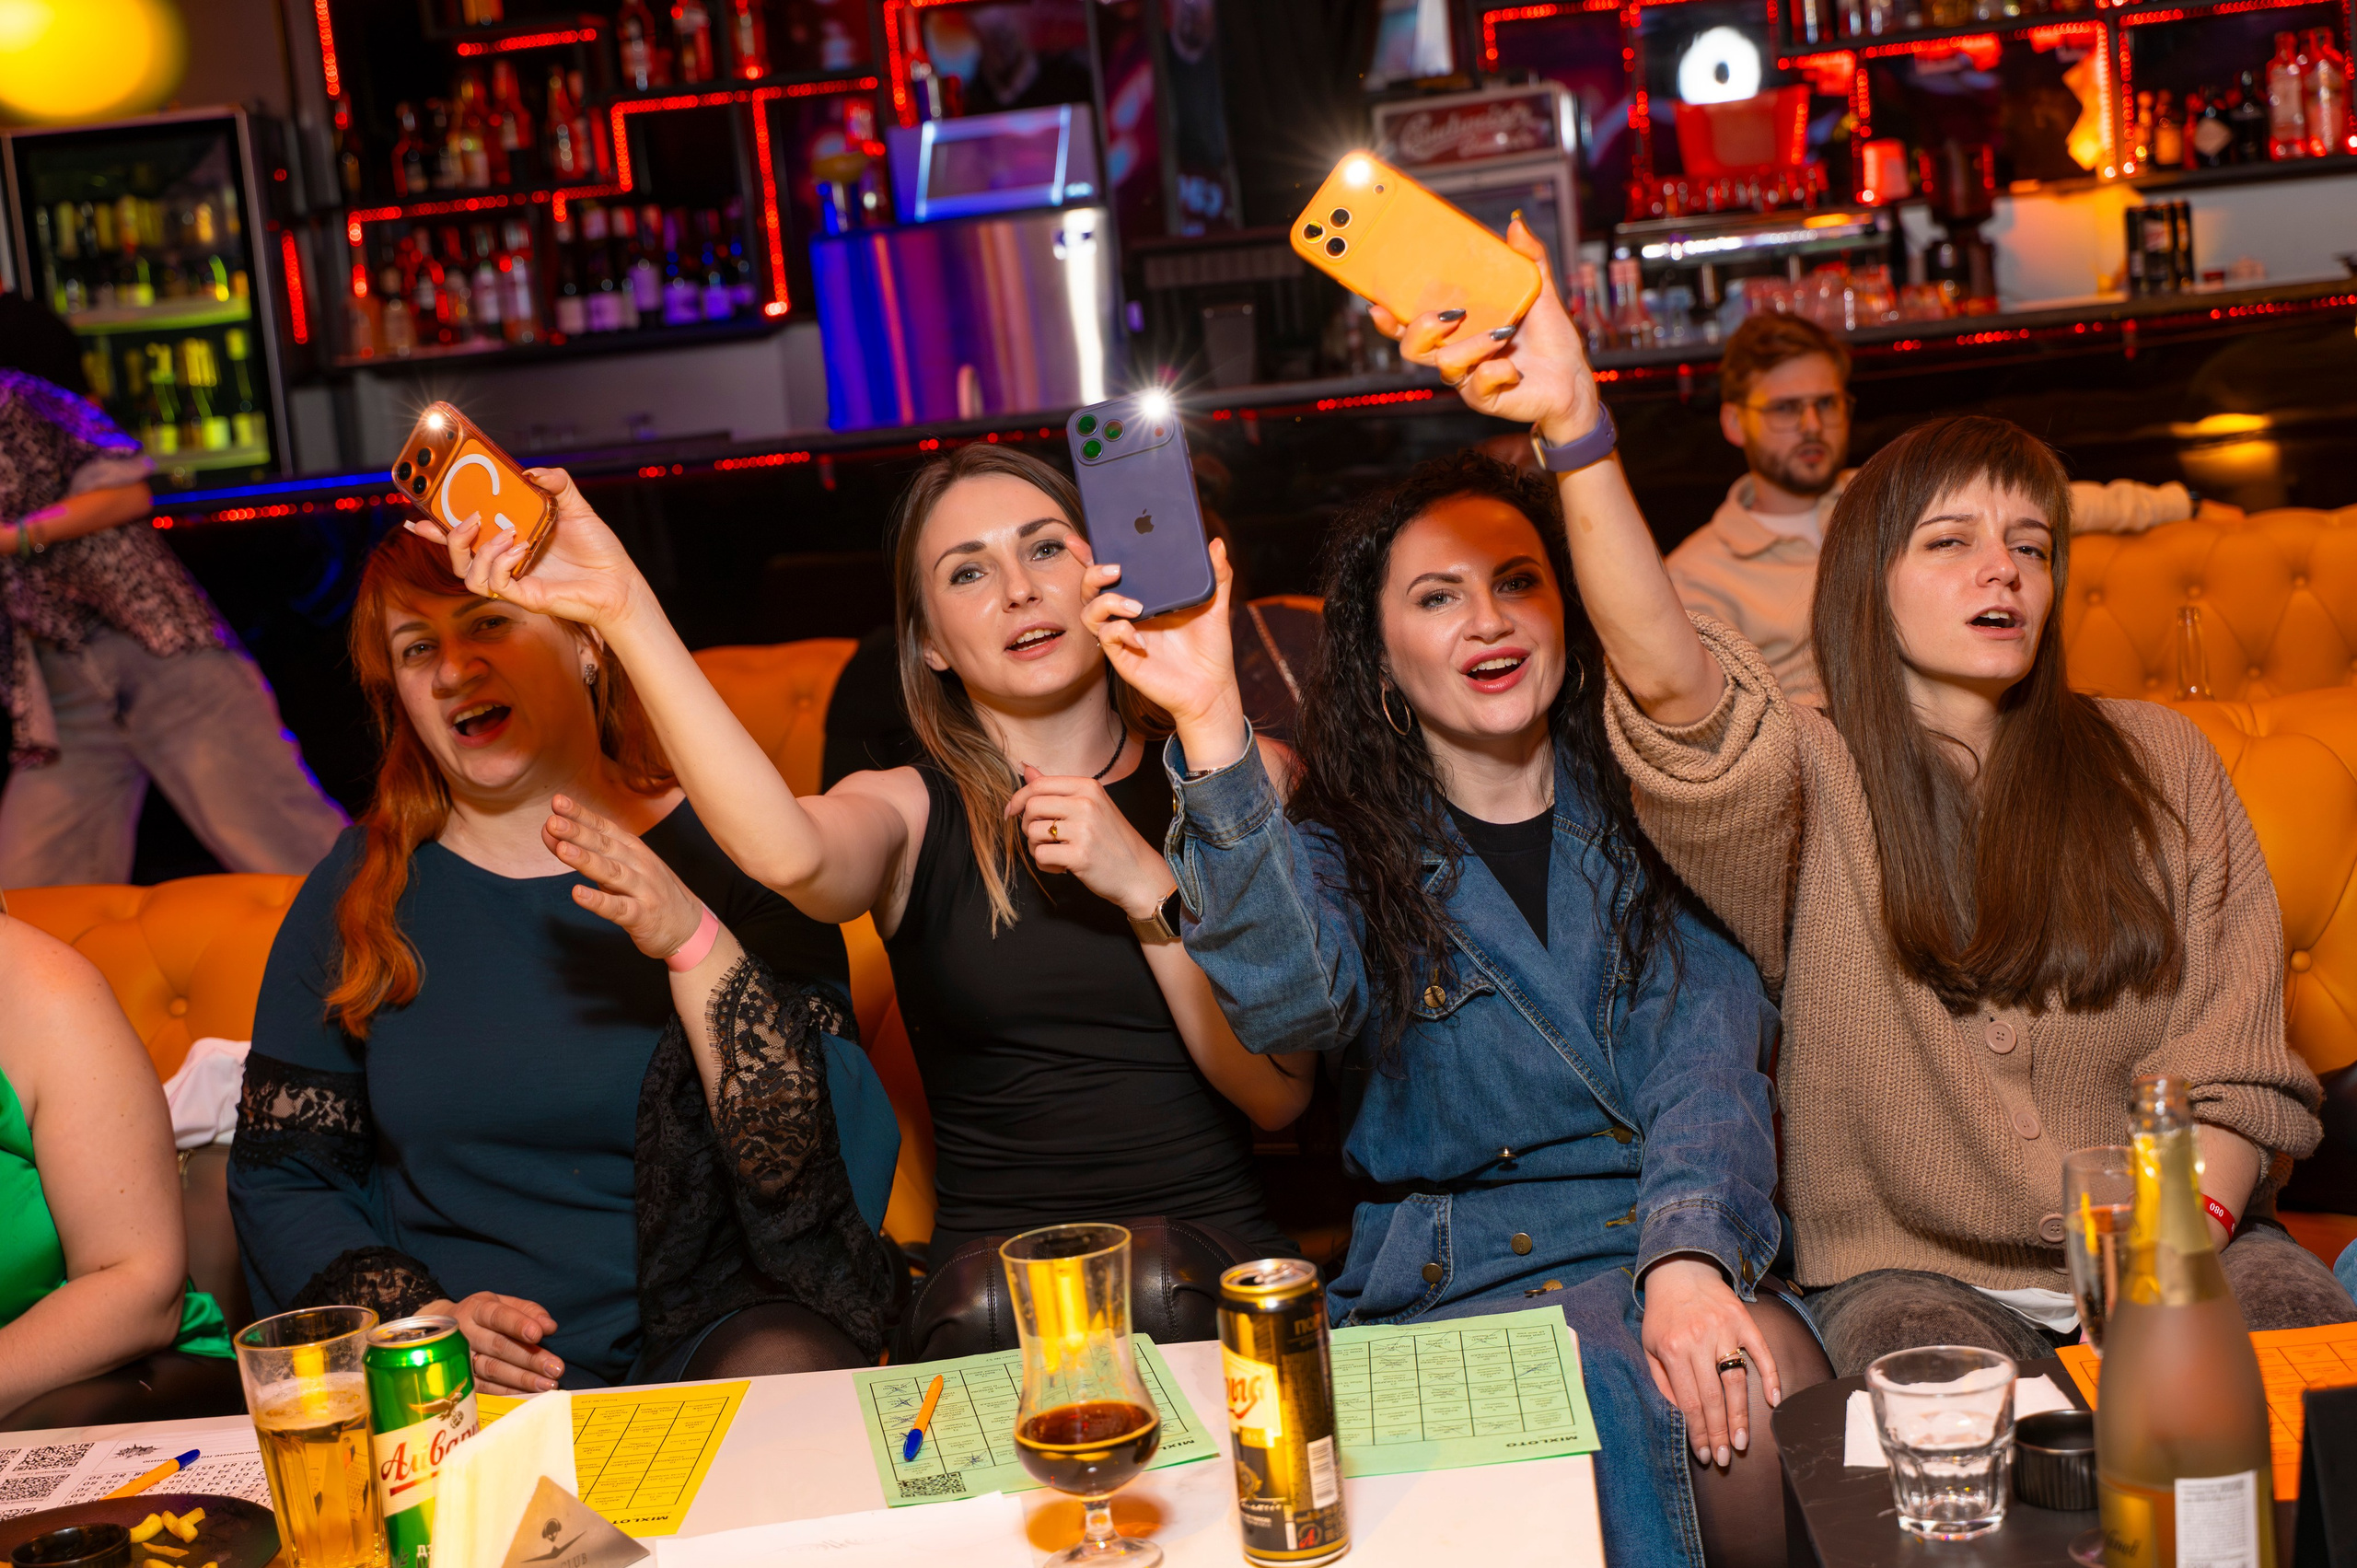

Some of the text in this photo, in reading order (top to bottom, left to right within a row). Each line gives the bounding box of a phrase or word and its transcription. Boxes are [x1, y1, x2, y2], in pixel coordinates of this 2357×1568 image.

[2210, 1202, 2223, 1217] 080
[1160, 1440, 1195, 1451] MIXL
[1506, 1436, 1578, 1447] MIXLOTO
[611, 1516, 669, 1525] MIXLOT
